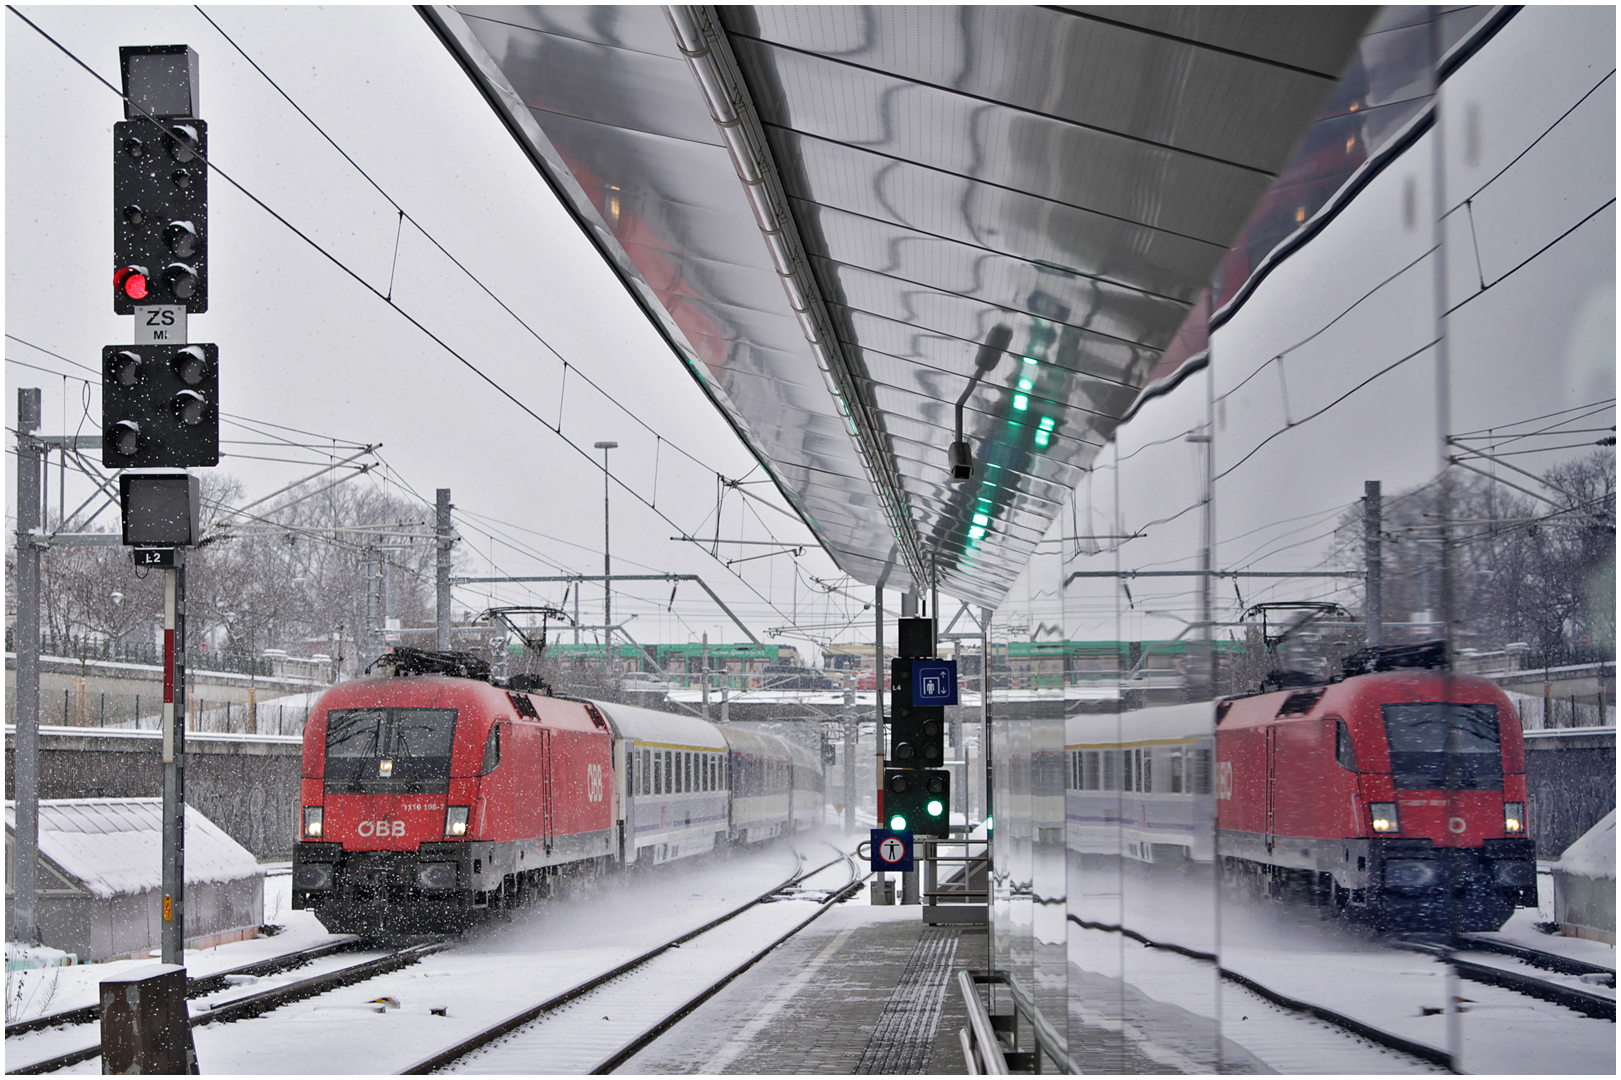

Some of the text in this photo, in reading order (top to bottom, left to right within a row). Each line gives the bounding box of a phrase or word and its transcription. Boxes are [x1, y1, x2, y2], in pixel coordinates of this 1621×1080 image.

[146, 310, 175, 326] ZS
[153, 330, 168, 340] Mi
[145, 552, 161, 564] L2
[357, 820, 406, 837] ÖBB
